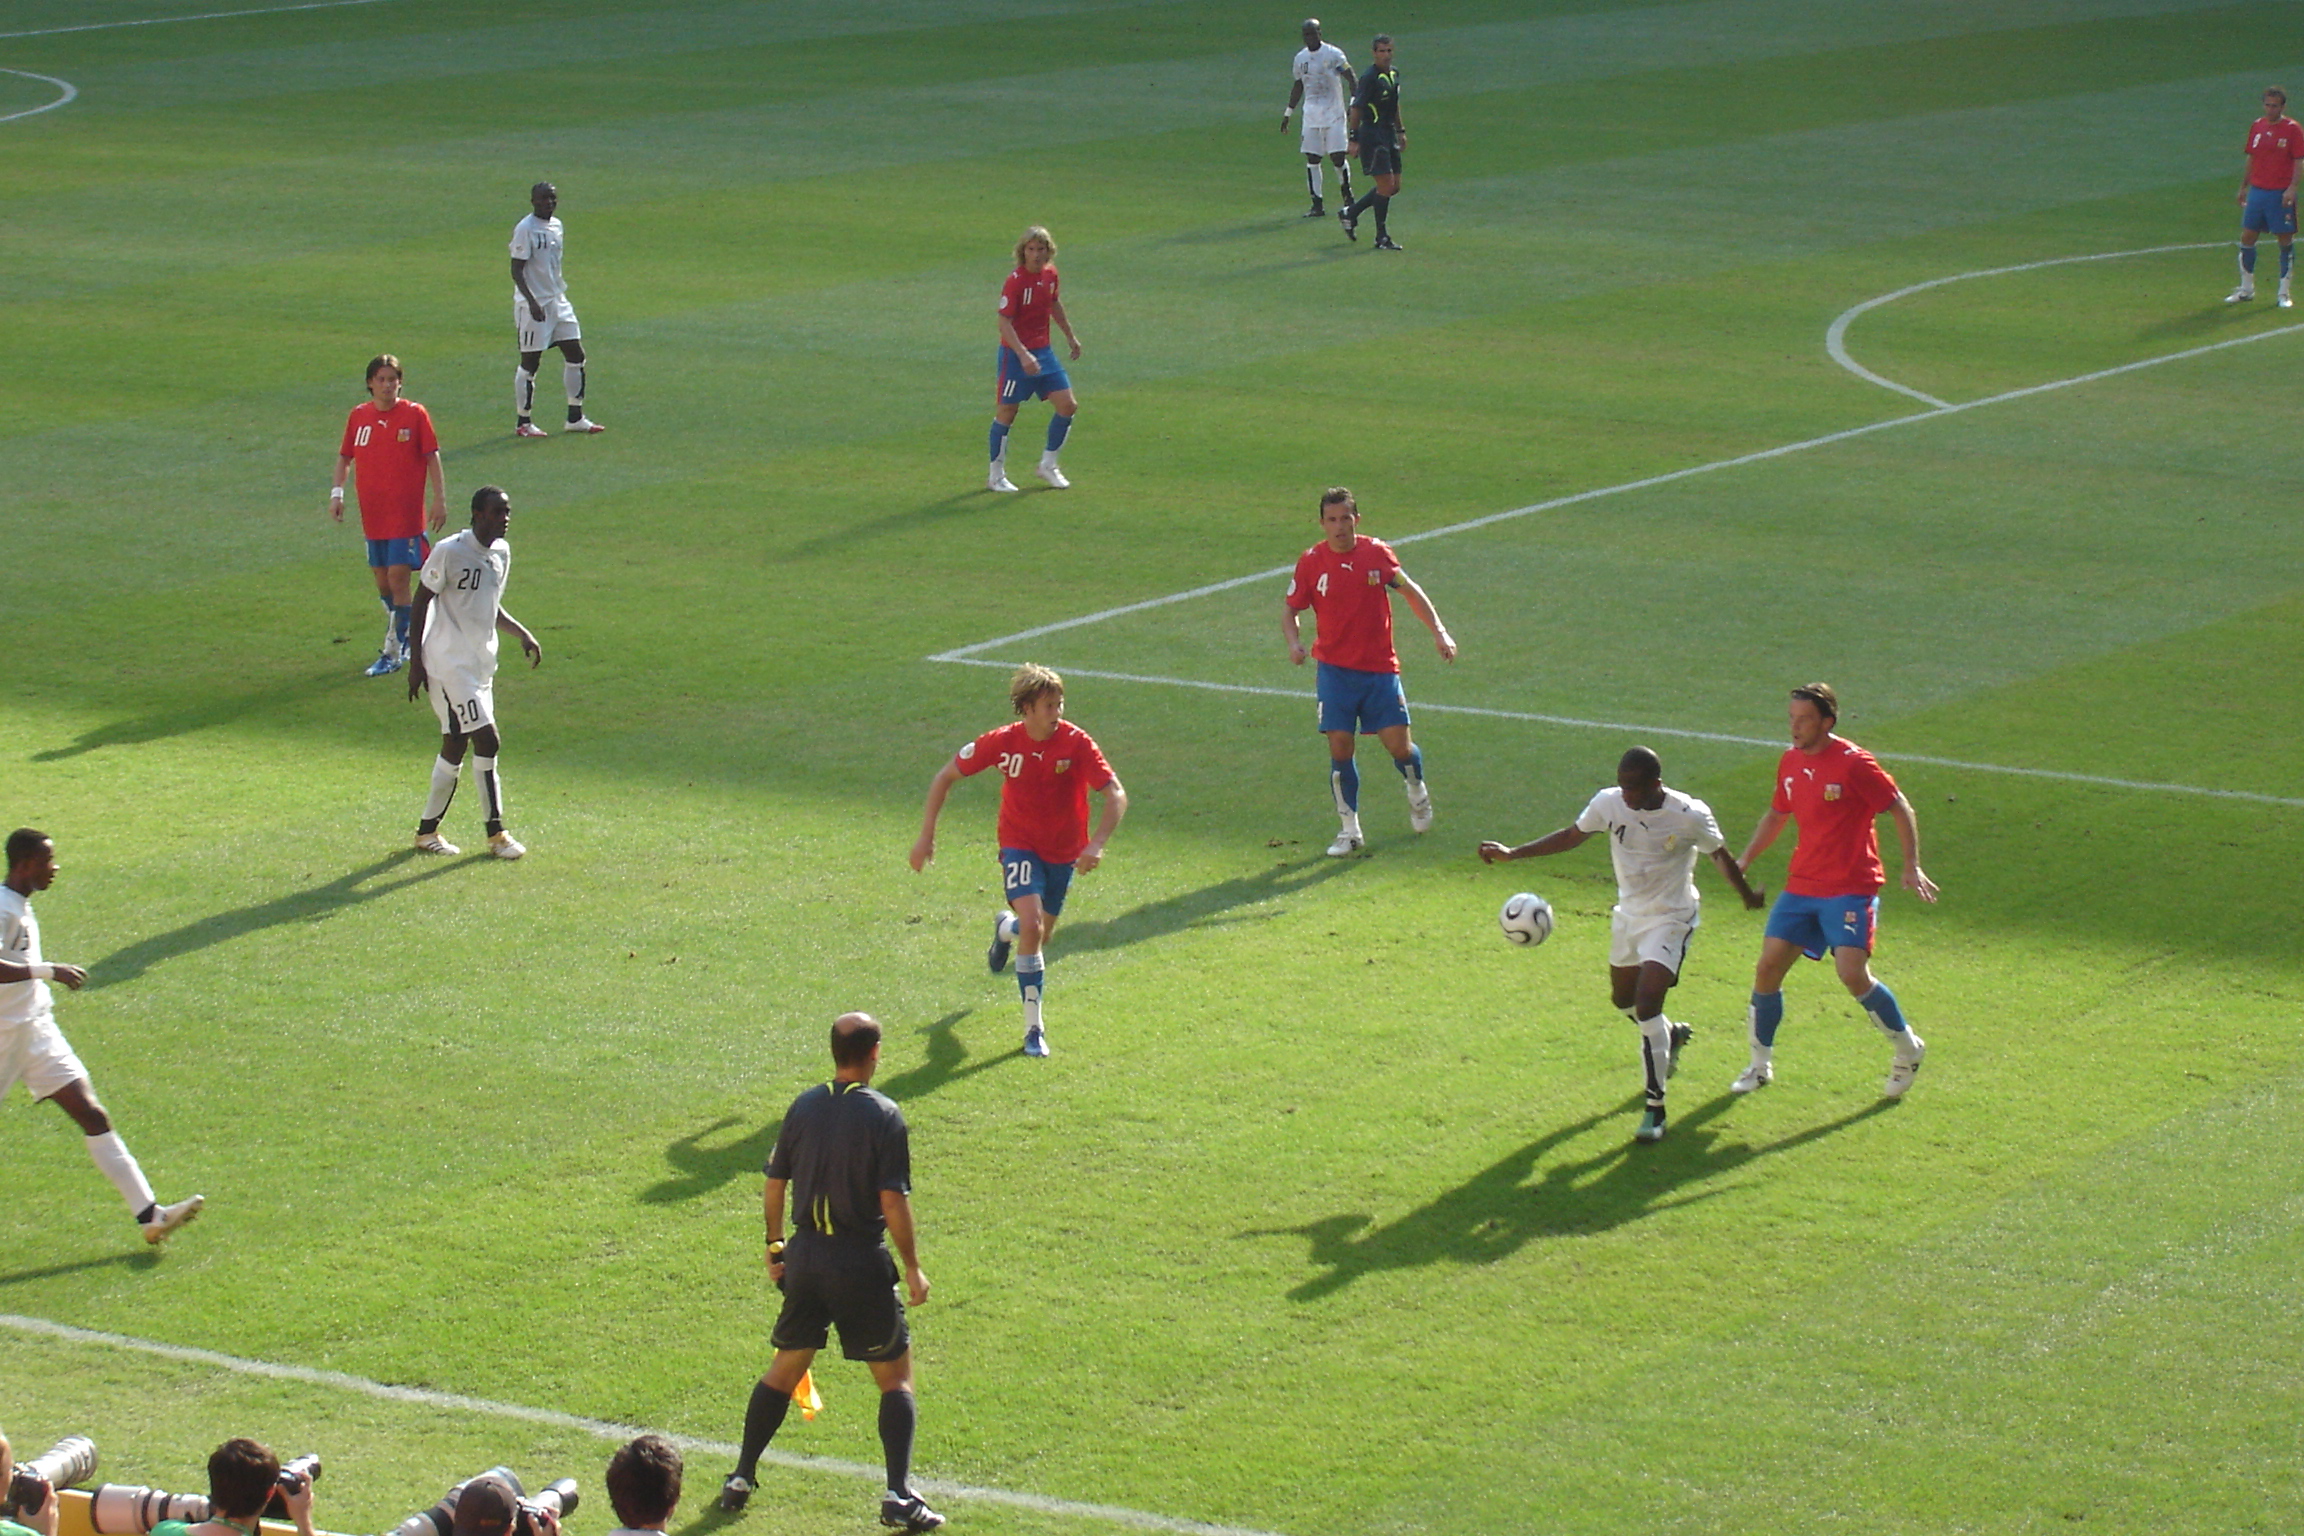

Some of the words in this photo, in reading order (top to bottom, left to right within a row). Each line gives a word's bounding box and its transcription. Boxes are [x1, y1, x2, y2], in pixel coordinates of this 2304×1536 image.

[1022, 287, 1033, 305] 11
[524, 330, 535, 346] 11
[1003, 379, 1017, 397] 11
[353, 425, 373, 447] 10
[457, 568, 482, 591] 20
[1316, 573, 1330, 597] 4
[998, 752, 1024, 778] 20
[1006, 860, 1032, 889] 20
